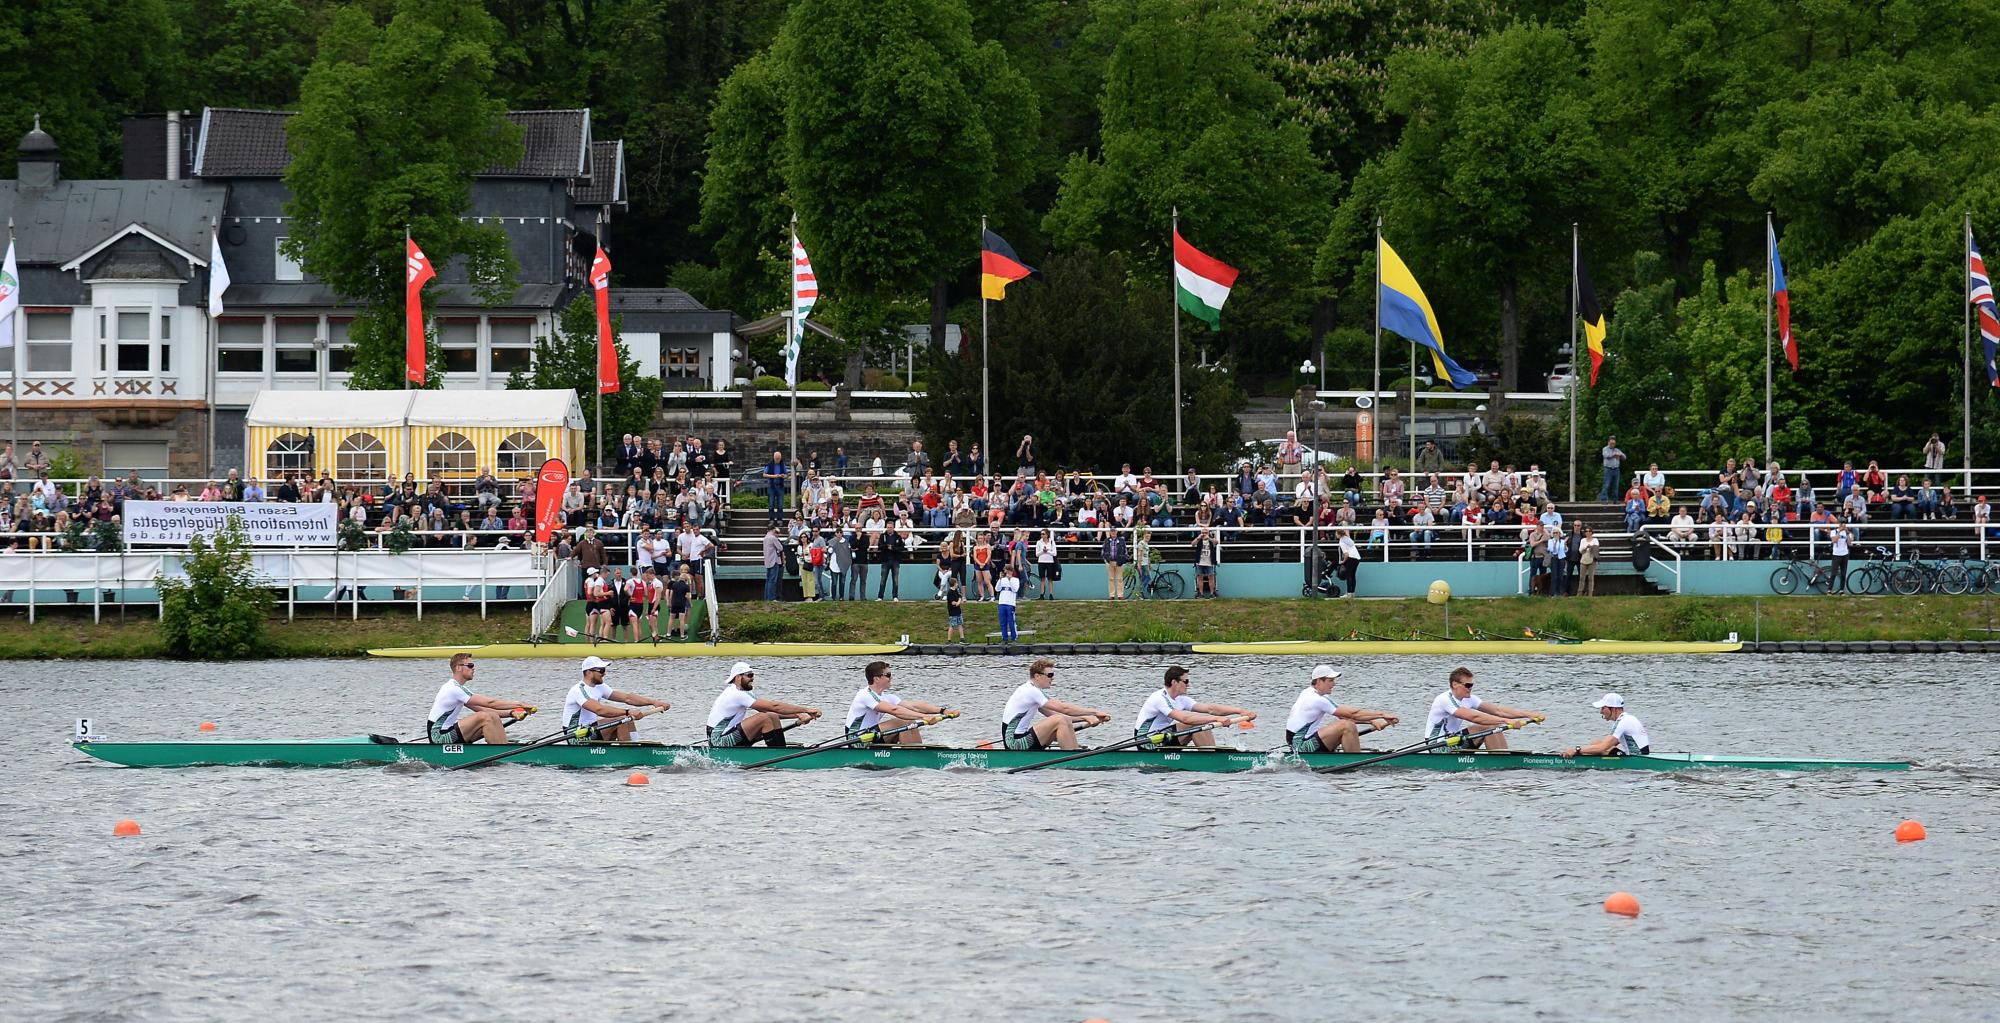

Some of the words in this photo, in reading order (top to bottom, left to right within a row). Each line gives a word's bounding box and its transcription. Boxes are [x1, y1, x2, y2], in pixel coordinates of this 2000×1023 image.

[80, 719, 88, 735] 5
[874, 750, 891, 758] wilo
[1523, 757, 1554, 765] Pioneering
